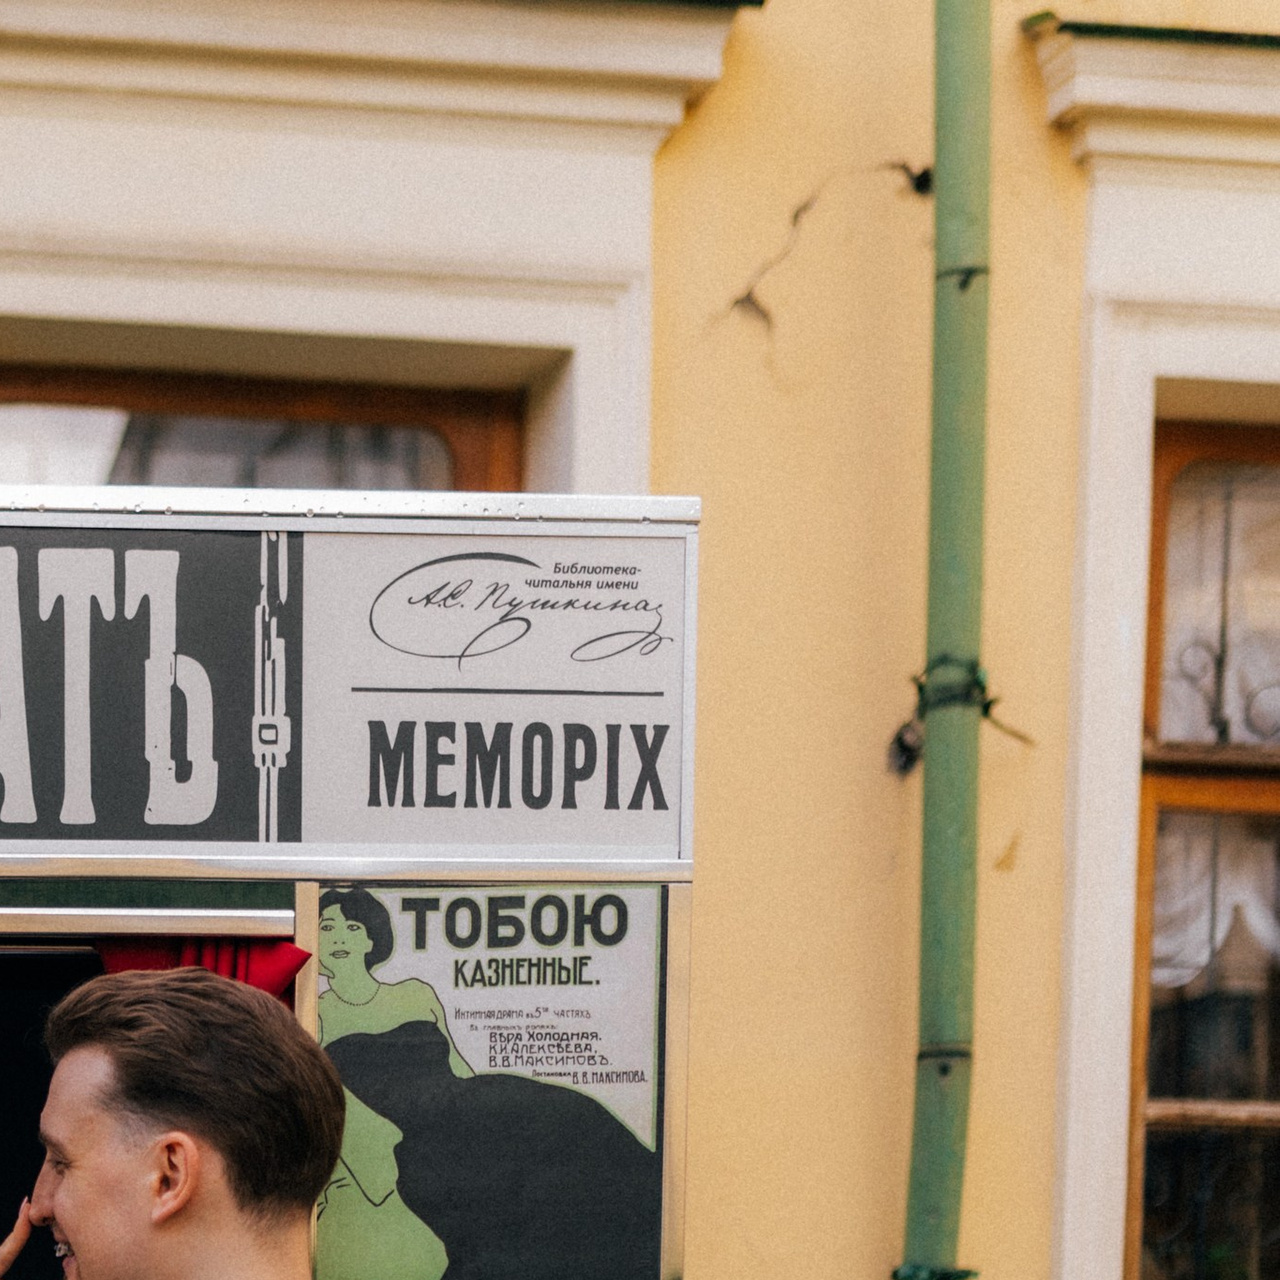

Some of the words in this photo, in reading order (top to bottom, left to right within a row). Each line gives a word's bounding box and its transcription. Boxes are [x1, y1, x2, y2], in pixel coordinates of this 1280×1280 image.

[552, 562, 642, 577] Библиотека-
[524, 577, 592, 591] читальня
[596, 579, 639, 591] имени
[401, 893, 629, 951] ТОБОЮ
[454, 955, 601, 988] КАЗНЕННЫЕ.
